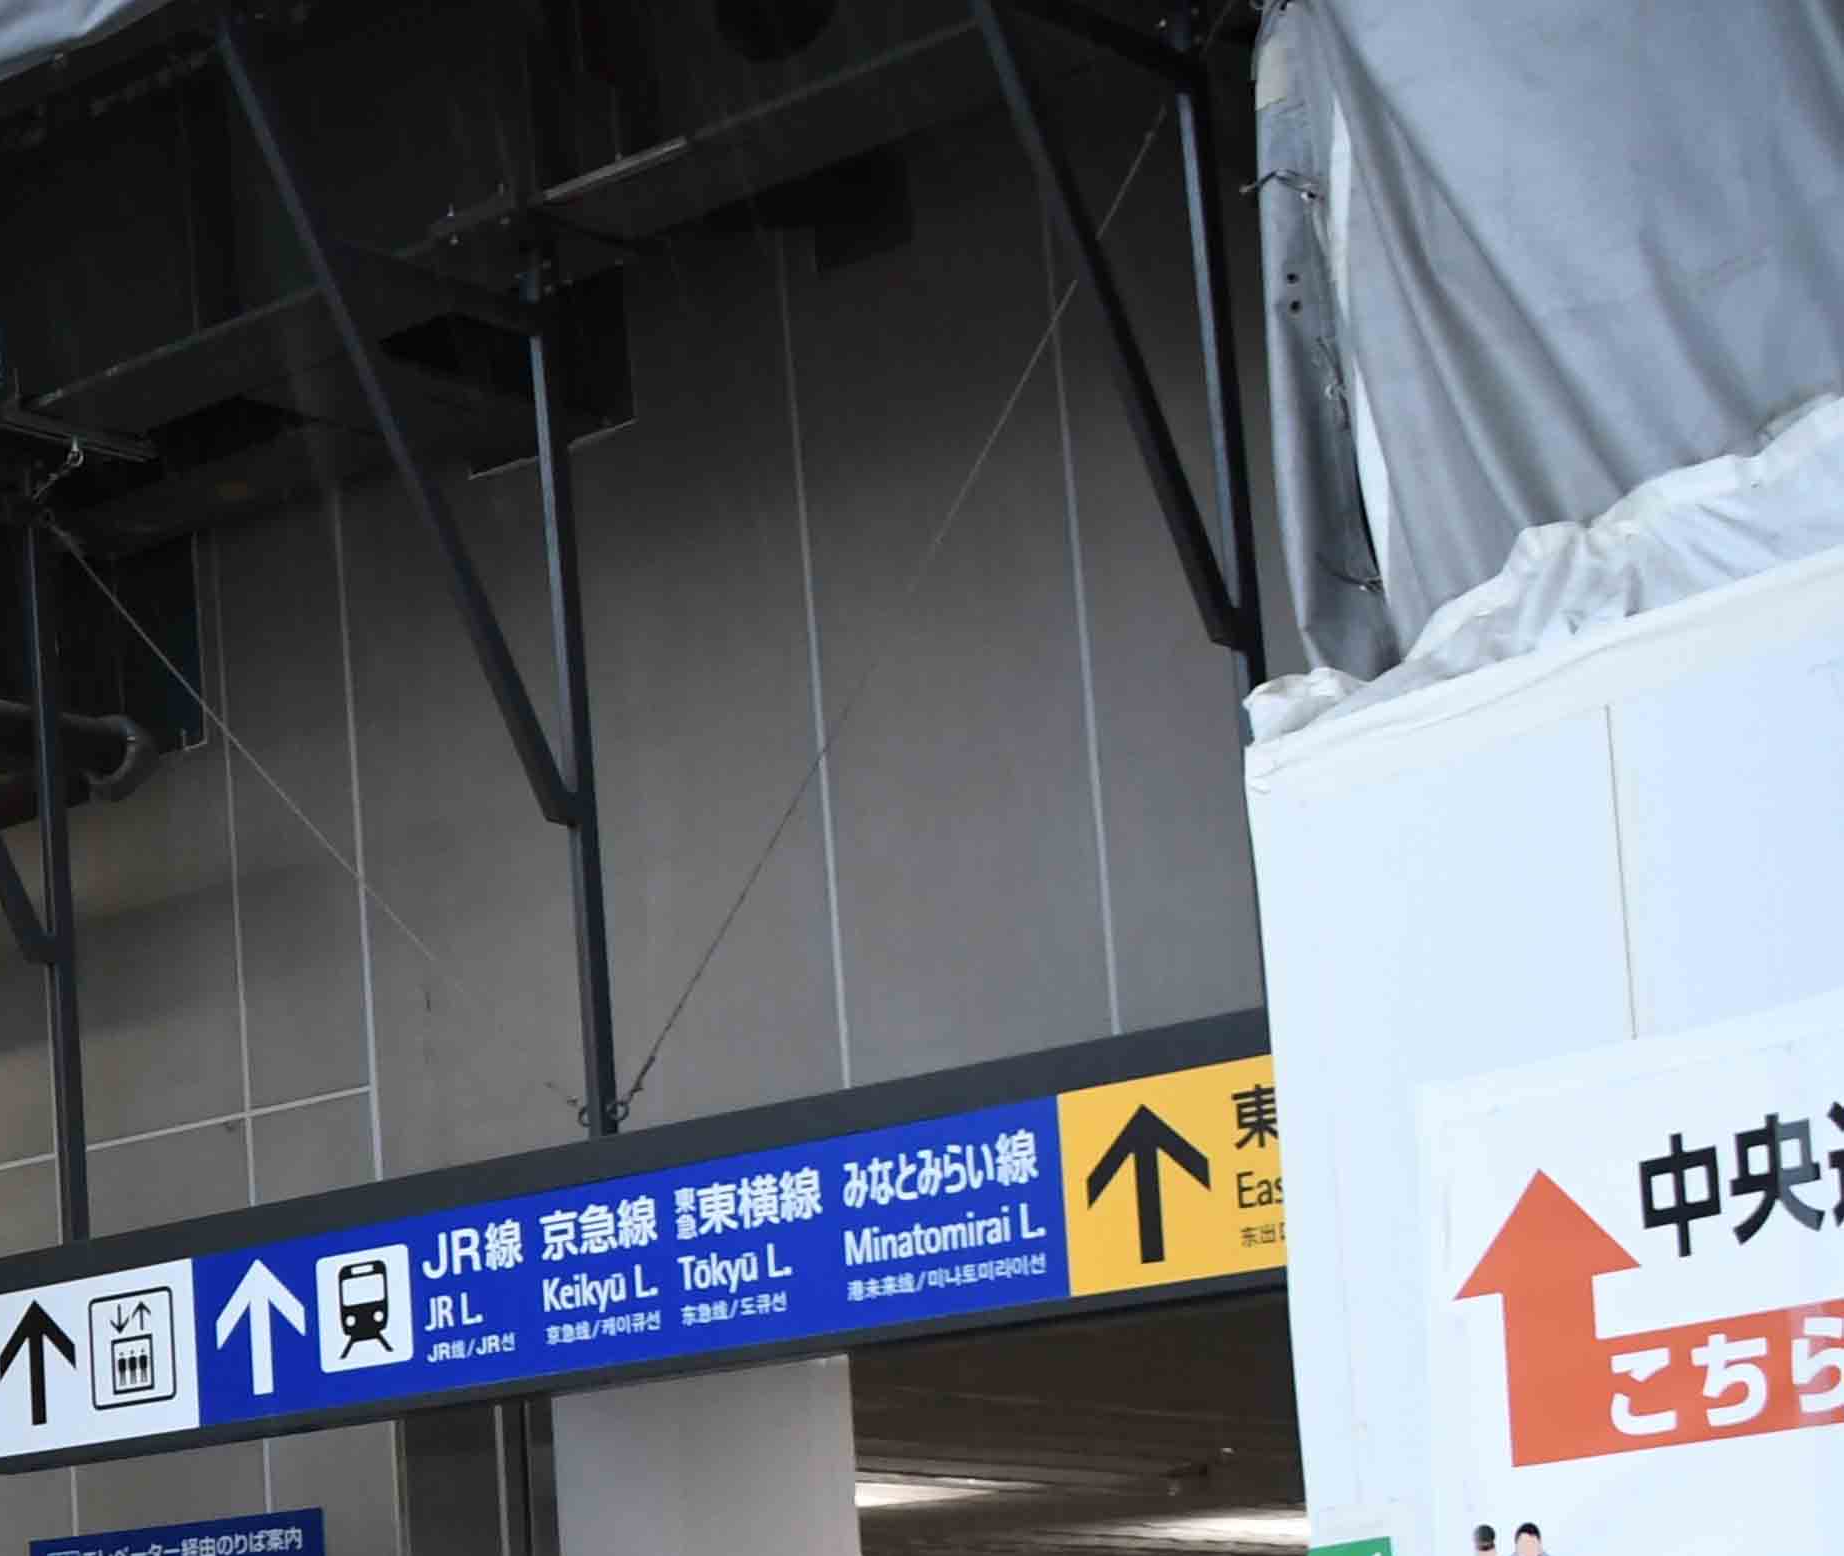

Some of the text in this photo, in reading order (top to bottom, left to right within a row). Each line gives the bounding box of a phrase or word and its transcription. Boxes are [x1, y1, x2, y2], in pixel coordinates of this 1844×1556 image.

[422, 1219, 524, 1279] JR線
[539, 1195, 658, 1261] 京急線
[842, 1129, 1039, 1209] みなとみらい線
[1639, 1101, 1844, 1257] 中央
[424, 1294, 454, 1332] JR
[460, 1292, 483, 1326] L.
[542, 1272, 626, 1313] Keikyū
[634, 1264, 658, 1298] L.
[677, 1251, 759, 1294] Tōkyū
[767, 1243, 792, 1278] L.
[844, 1205, 1010, 1266] Minatomirai
[1019, 1203, 1046, 1239] L.
